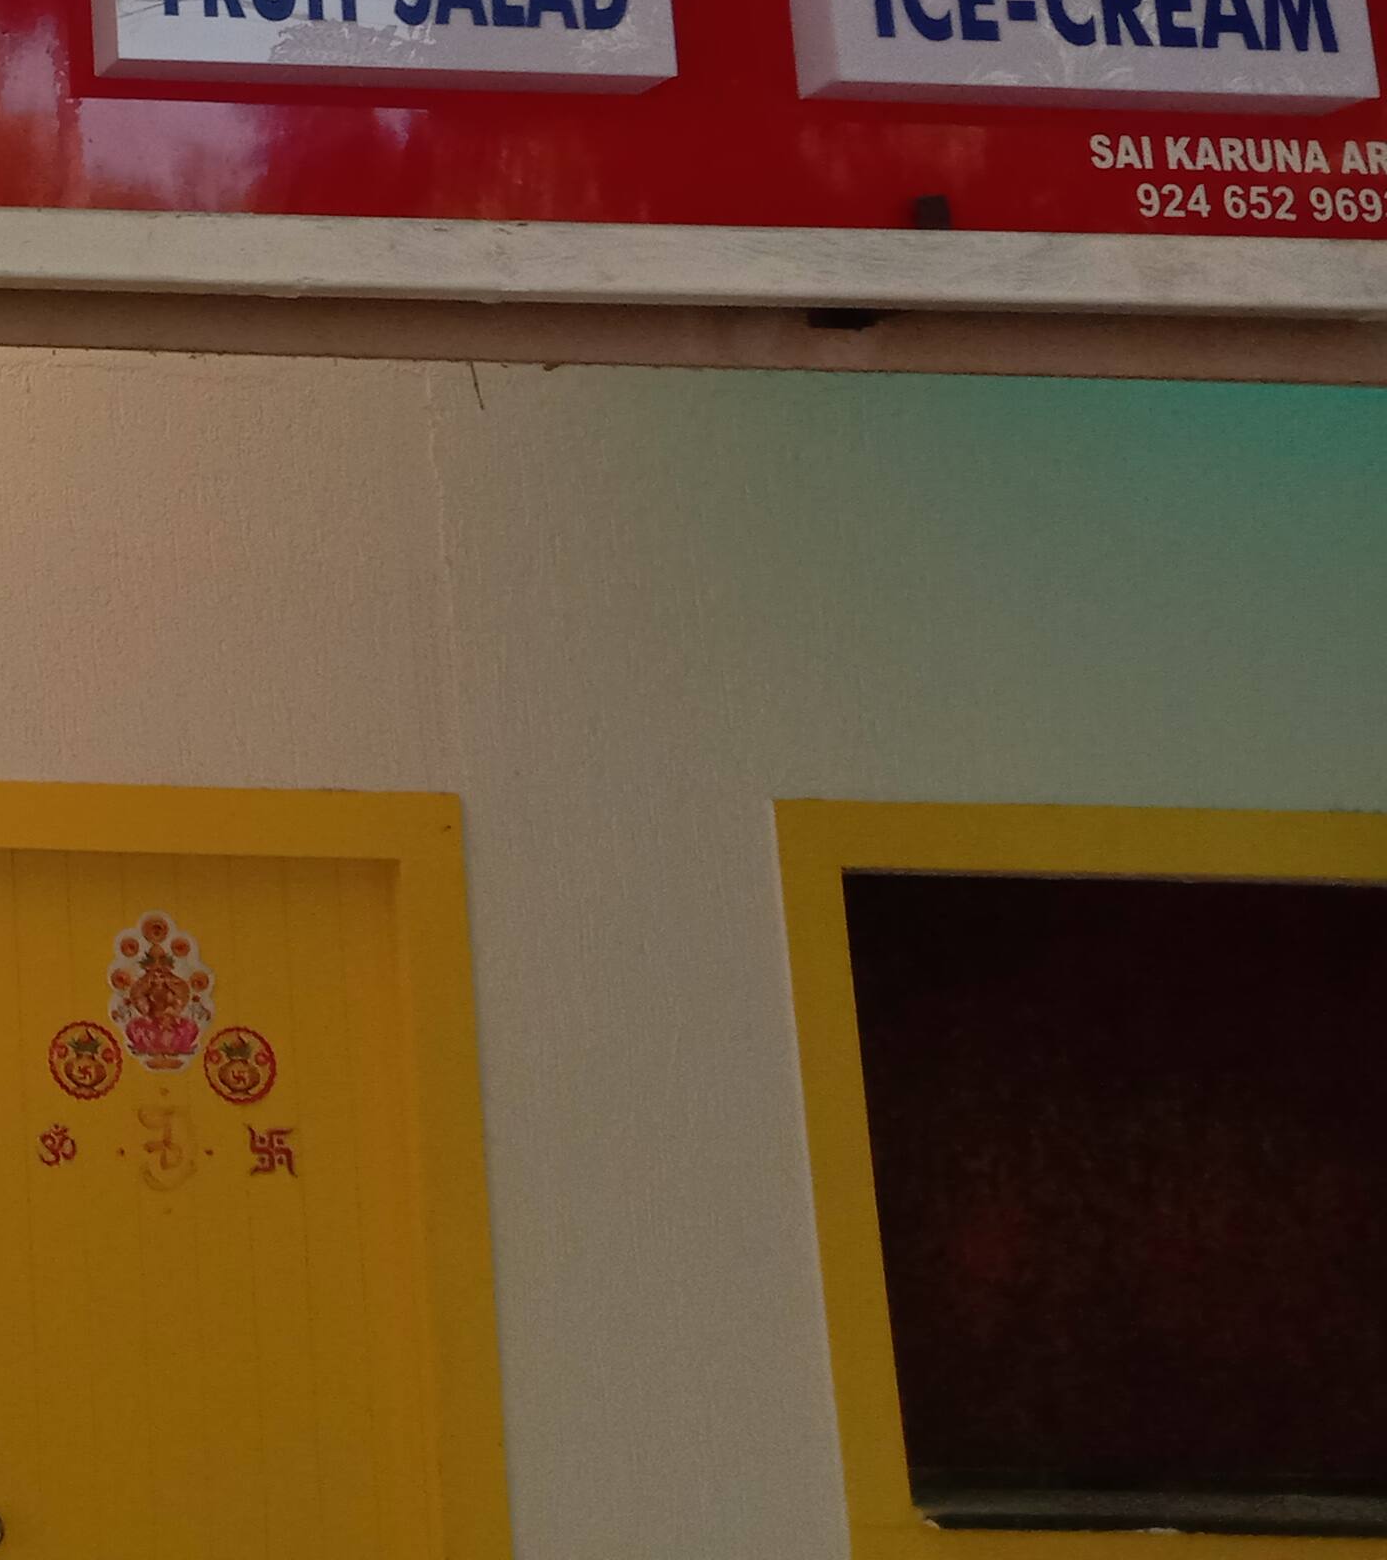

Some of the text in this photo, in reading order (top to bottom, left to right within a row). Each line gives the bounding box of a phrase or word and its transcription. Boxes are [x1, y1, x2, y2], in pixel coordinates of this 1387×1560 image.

[1089, 134, 1155, 170] SAI
[1164, 136, 1331, 174] KARUNA
[1136, 183, 1387, 224] 924 652 969
